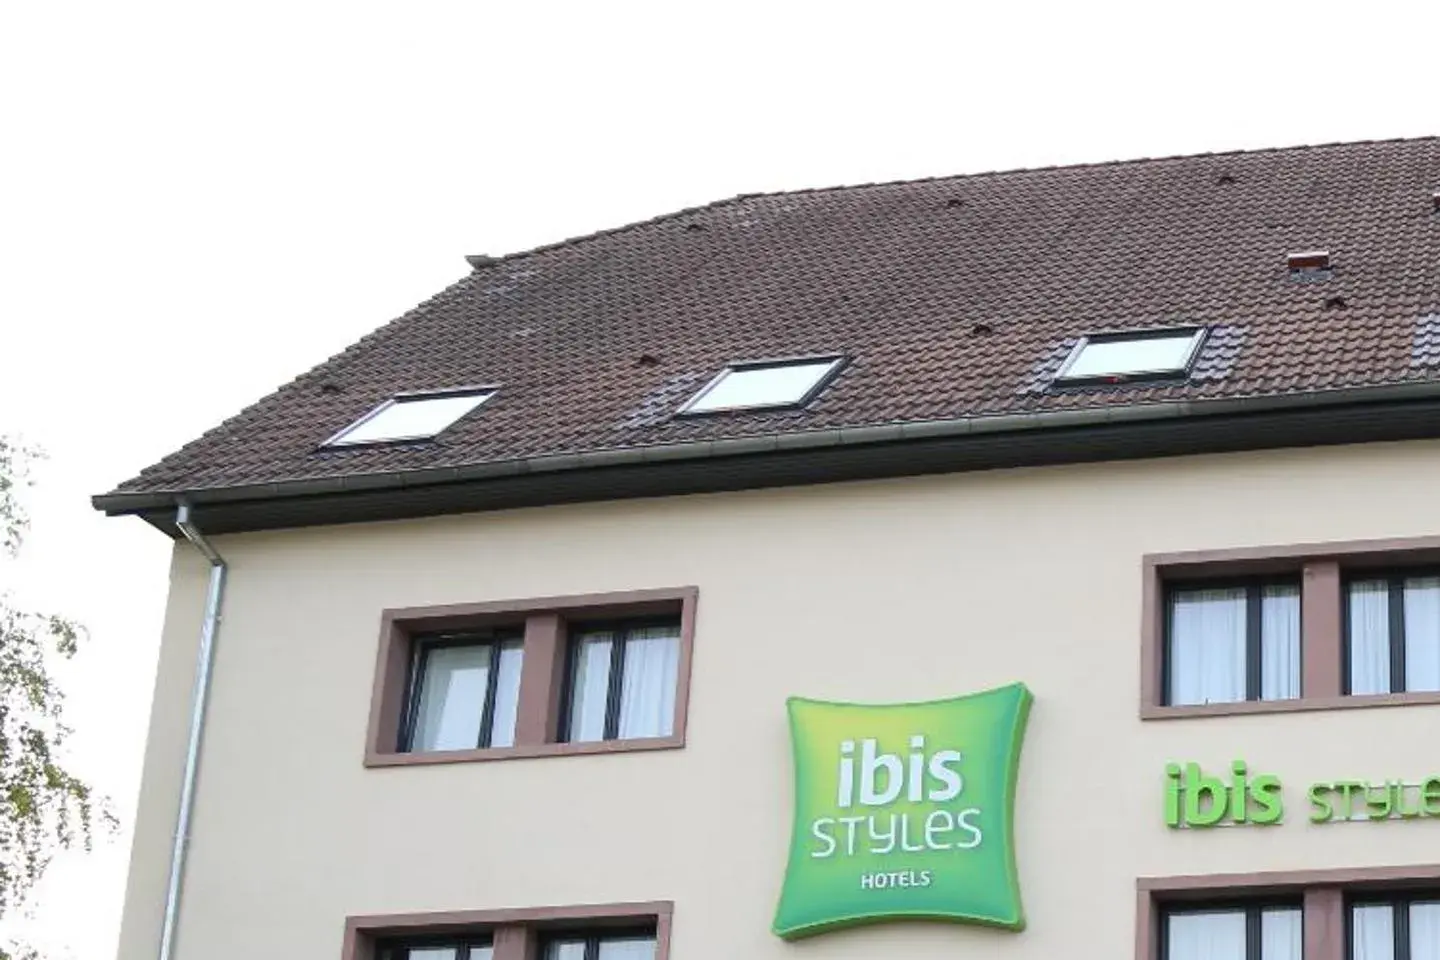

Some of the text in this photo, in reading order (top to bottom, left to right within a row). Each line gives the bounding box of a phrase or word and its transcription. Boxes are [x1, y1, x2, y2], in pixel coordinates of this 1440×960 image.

[837, 735, 962, 807] ibis
[1165, 760, 1284, 828] ibis
[860, 871, 930, 889] HOTELS
